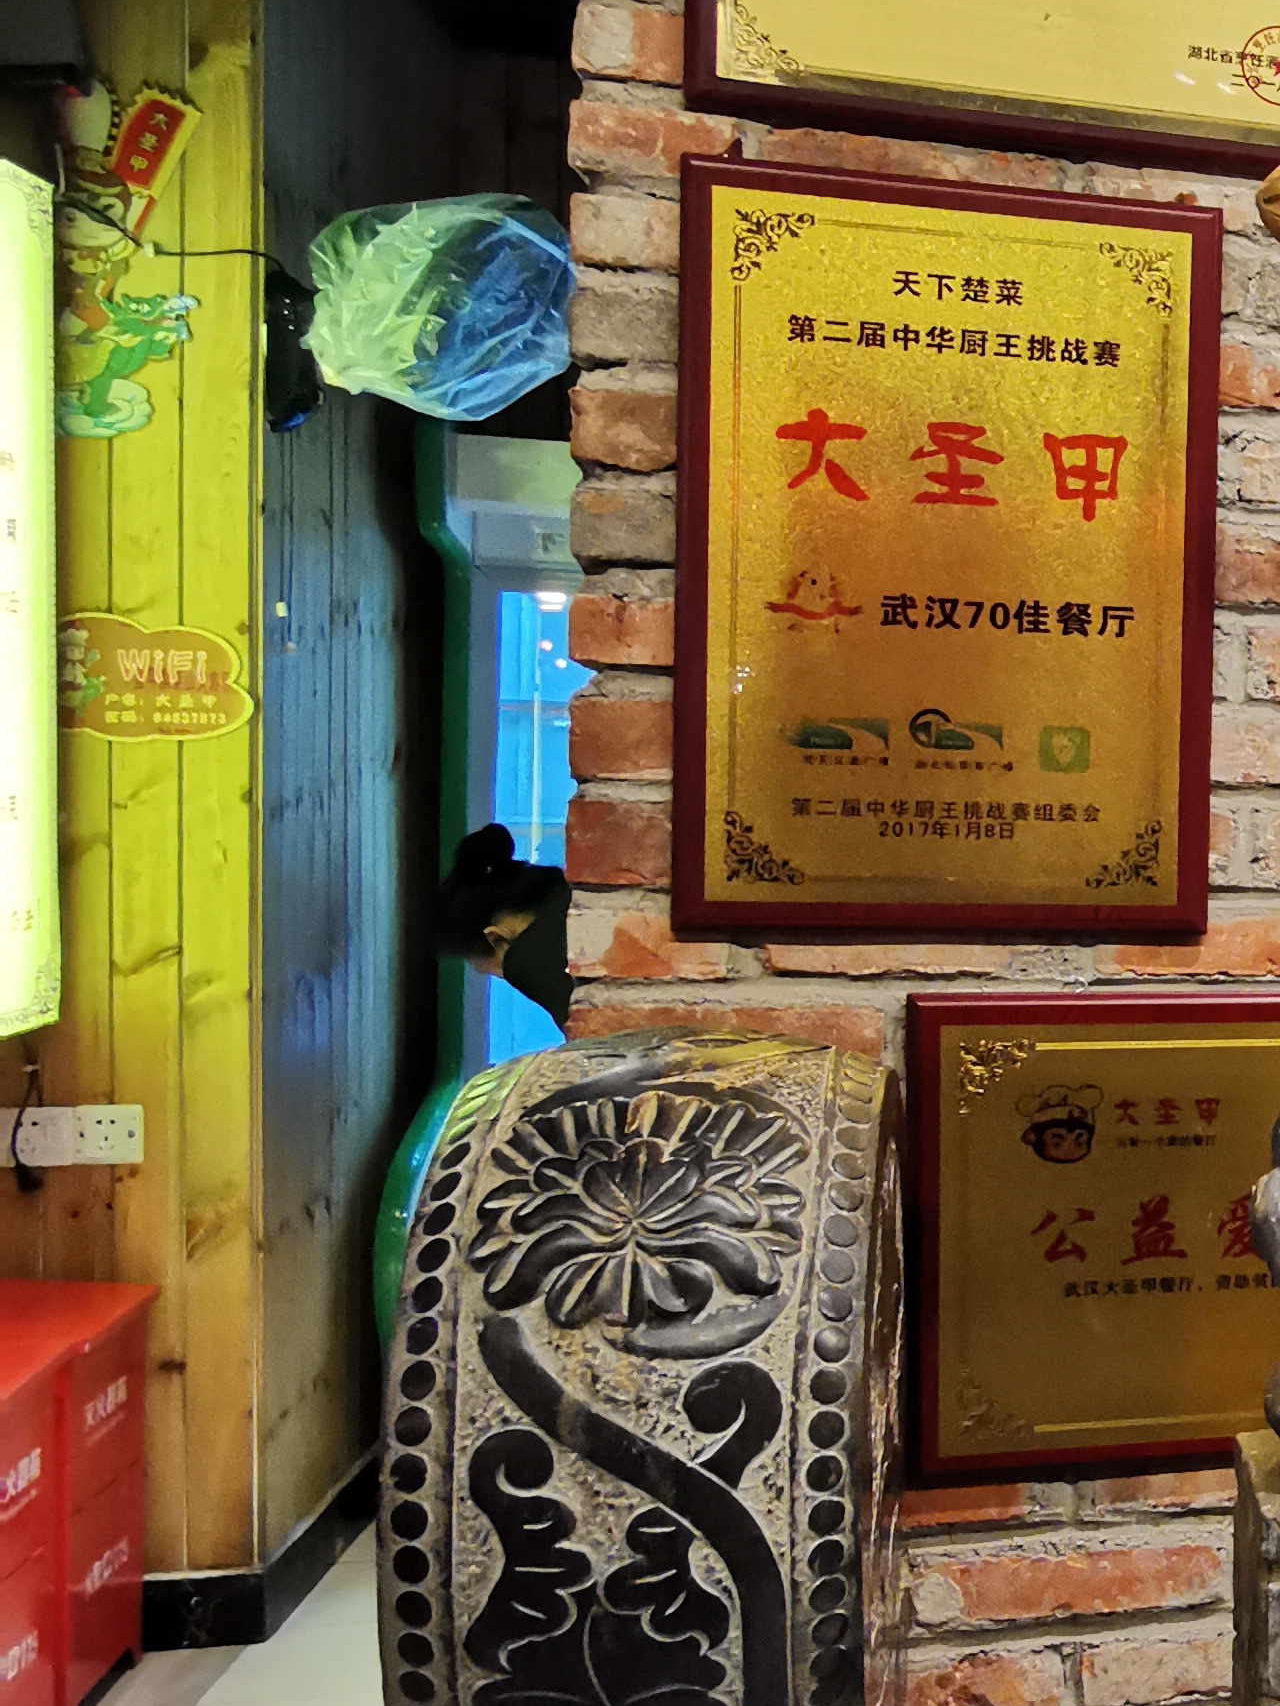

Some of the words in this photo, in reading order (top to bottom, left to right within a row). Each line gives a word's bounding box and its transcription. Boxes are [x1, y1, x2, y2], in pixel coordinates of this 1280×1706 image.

[893, 270, 1023, 306] 天下楚菜
[787, 314, 1120, 368] 第二届中华厨王挑战赛
[775, 409, 1128, 522] 大圣甲
[880, 593, 1134, 638] 武汉70佳餐厅
[116, 648, 208, 685] WiFi
[791, 798, 1101, 823] 第二届中华厨王挑战赛组委会
[879, 821, 1015, 840] 2017年1月8日
[1114, 1097, 1221, 1126] 大圣甲
